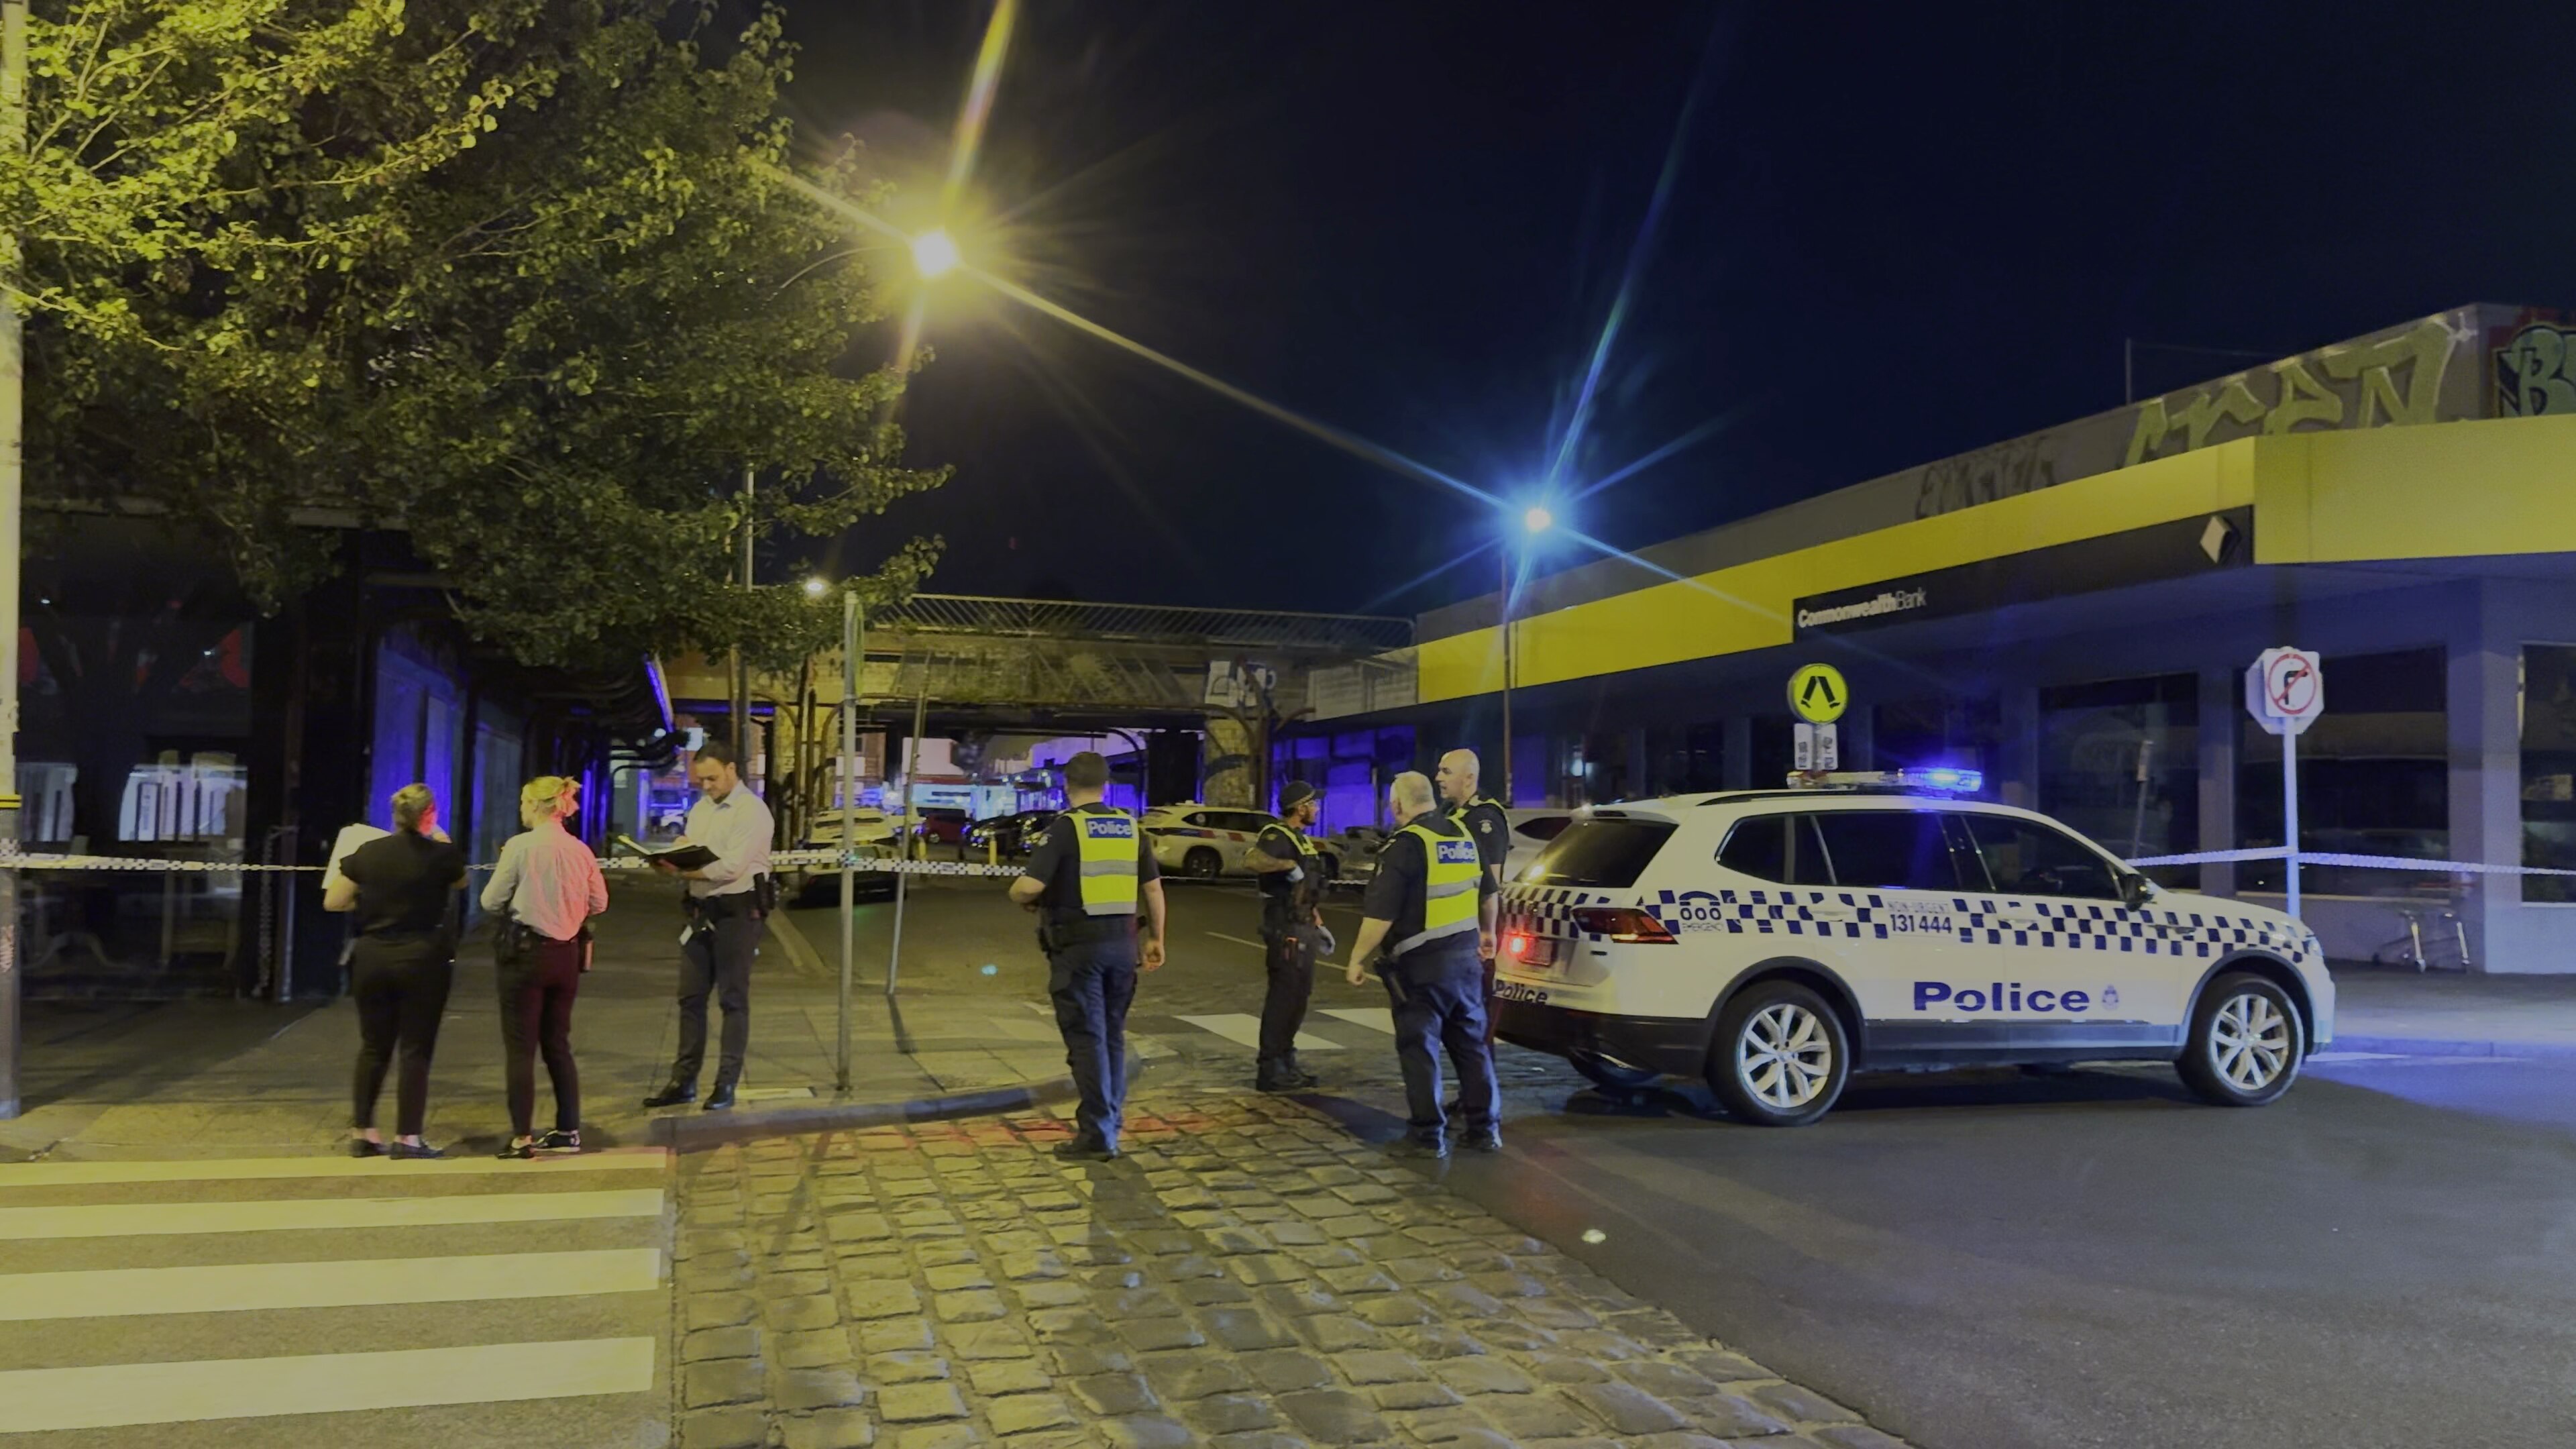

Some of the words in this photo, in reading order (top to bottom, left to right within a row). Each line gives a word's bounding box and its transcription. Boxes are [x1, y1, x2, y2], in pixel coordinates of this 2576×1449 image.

[1798, 587, 1927, 628] CommonwealthBank
[1087, 820, 1132, 835] Police
[1438, 843, 1475, 859] Police
[1493, 979, 1548, 1004] Police
[1914, 981, 2090, 1012] Police
